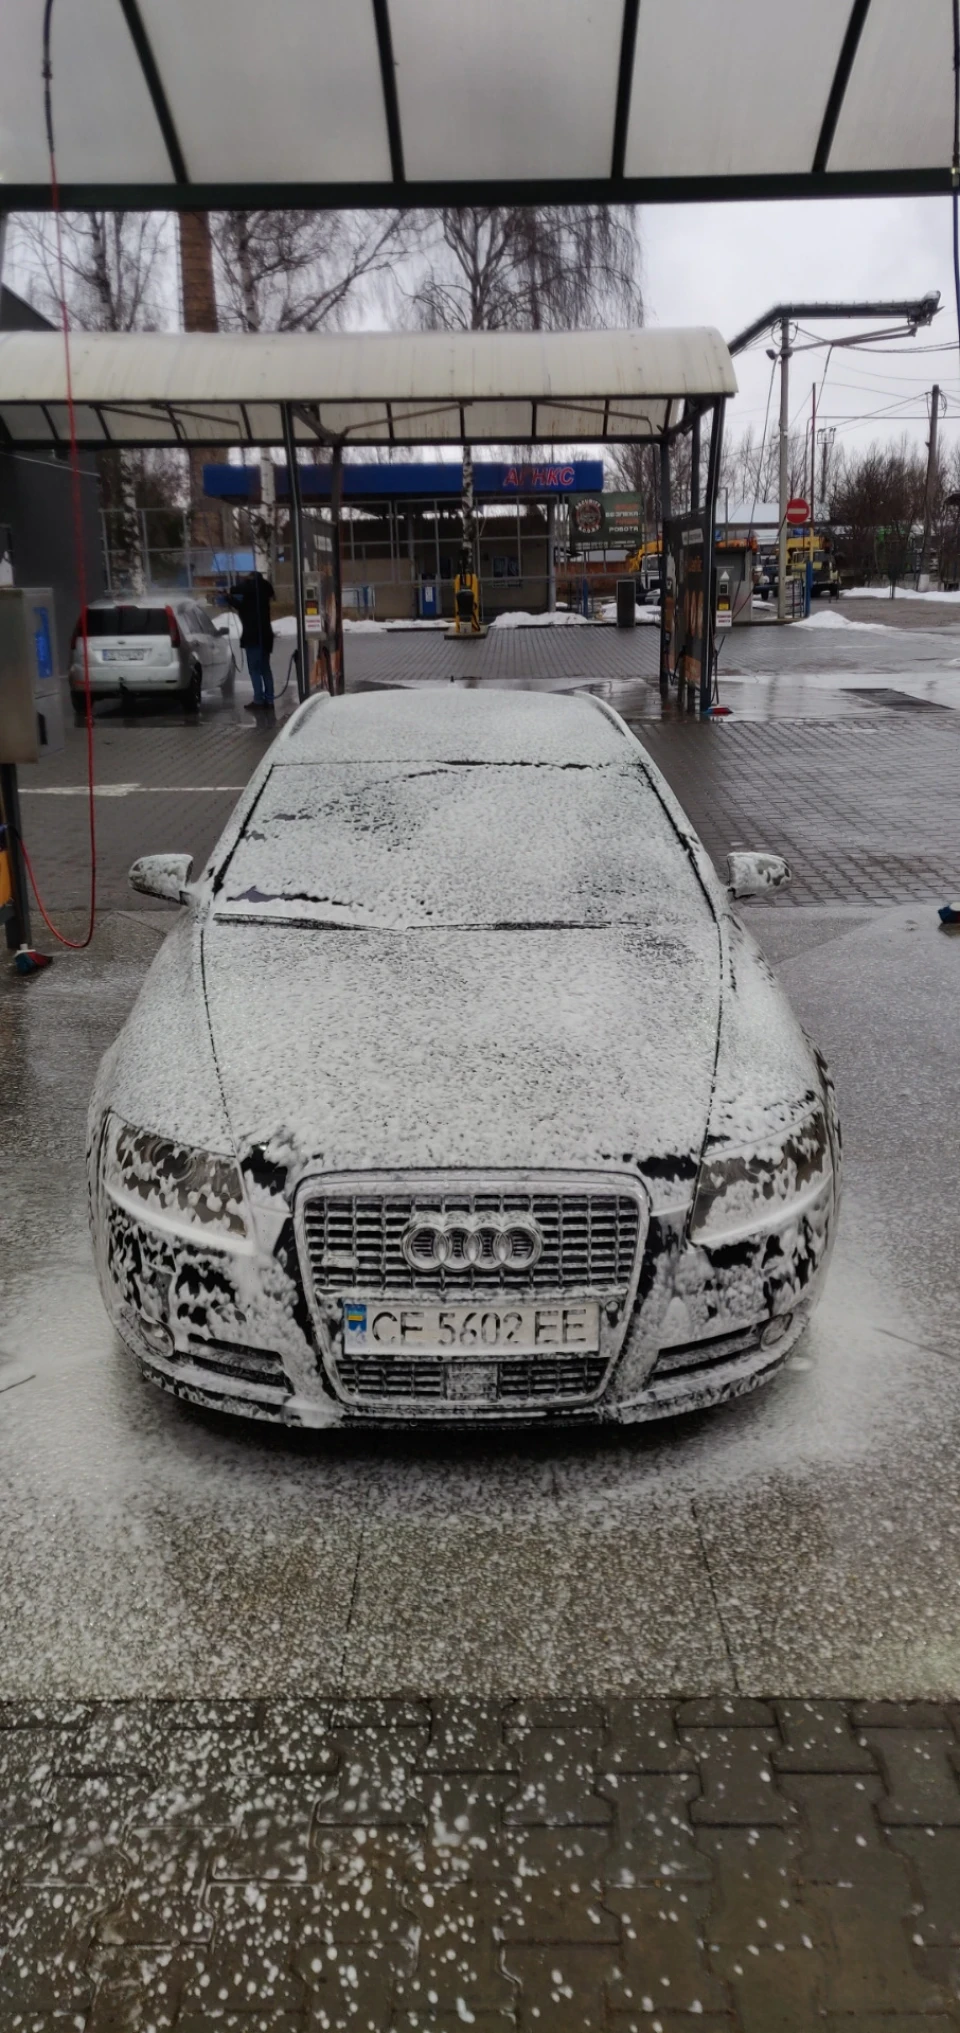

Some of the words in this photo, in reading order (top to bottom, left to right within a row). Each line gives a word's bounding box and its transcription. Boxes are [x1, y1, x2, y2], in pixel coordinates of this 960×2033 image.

[502, 466, 576, 486] АГНКС
[438, 1312, 523, 1345] 5602
[534, 1309, 587, 1345] EE
